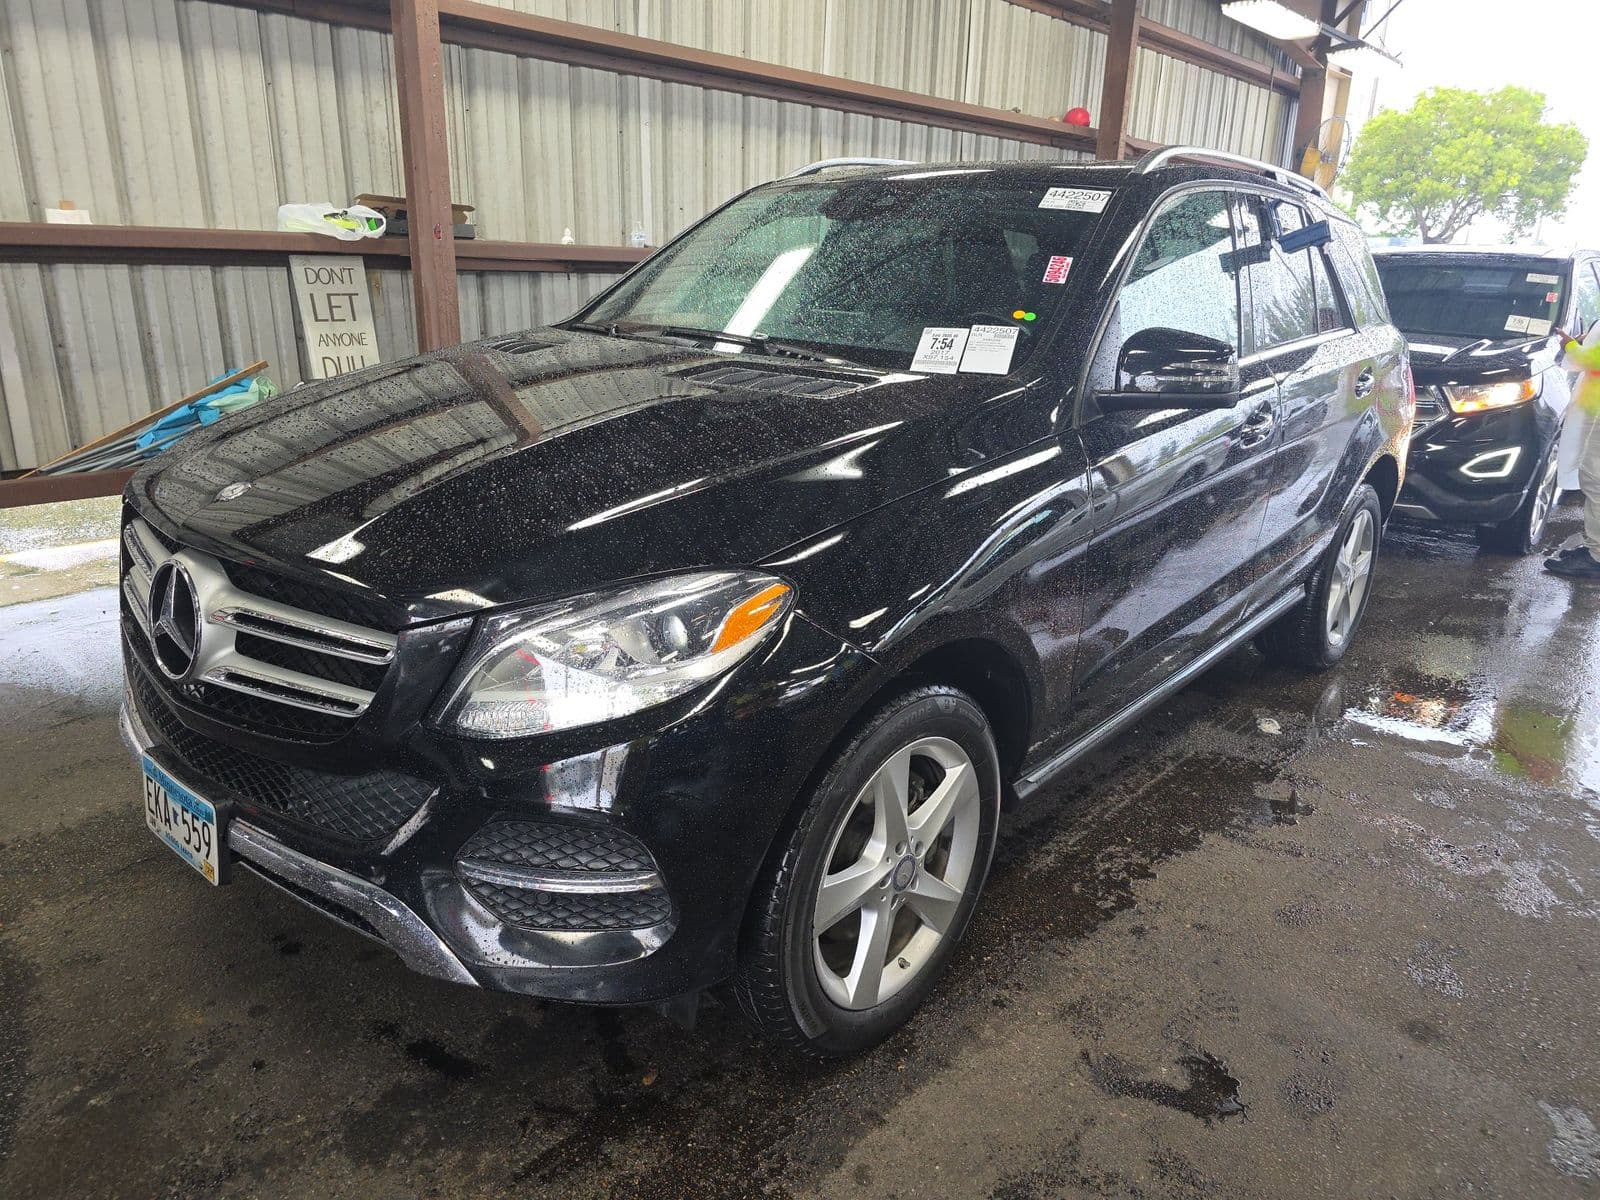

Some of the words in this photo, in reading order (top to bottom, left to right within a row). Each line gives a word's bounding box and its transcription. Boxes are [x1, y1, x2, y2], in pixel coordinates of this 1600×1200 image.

[1049, 189, 1112, 202] 4422507
[304, 267, 354, 285] DON'T
[309, 293, 359, 322] LET
[974, 326, 1018, 335] 4422507
[318, 332, 368, 347] ANYONE
[930, 337, 954, 350] 7:54
[146, 775, 171, 831] EKA
[181, 805, 211, 860] 559
